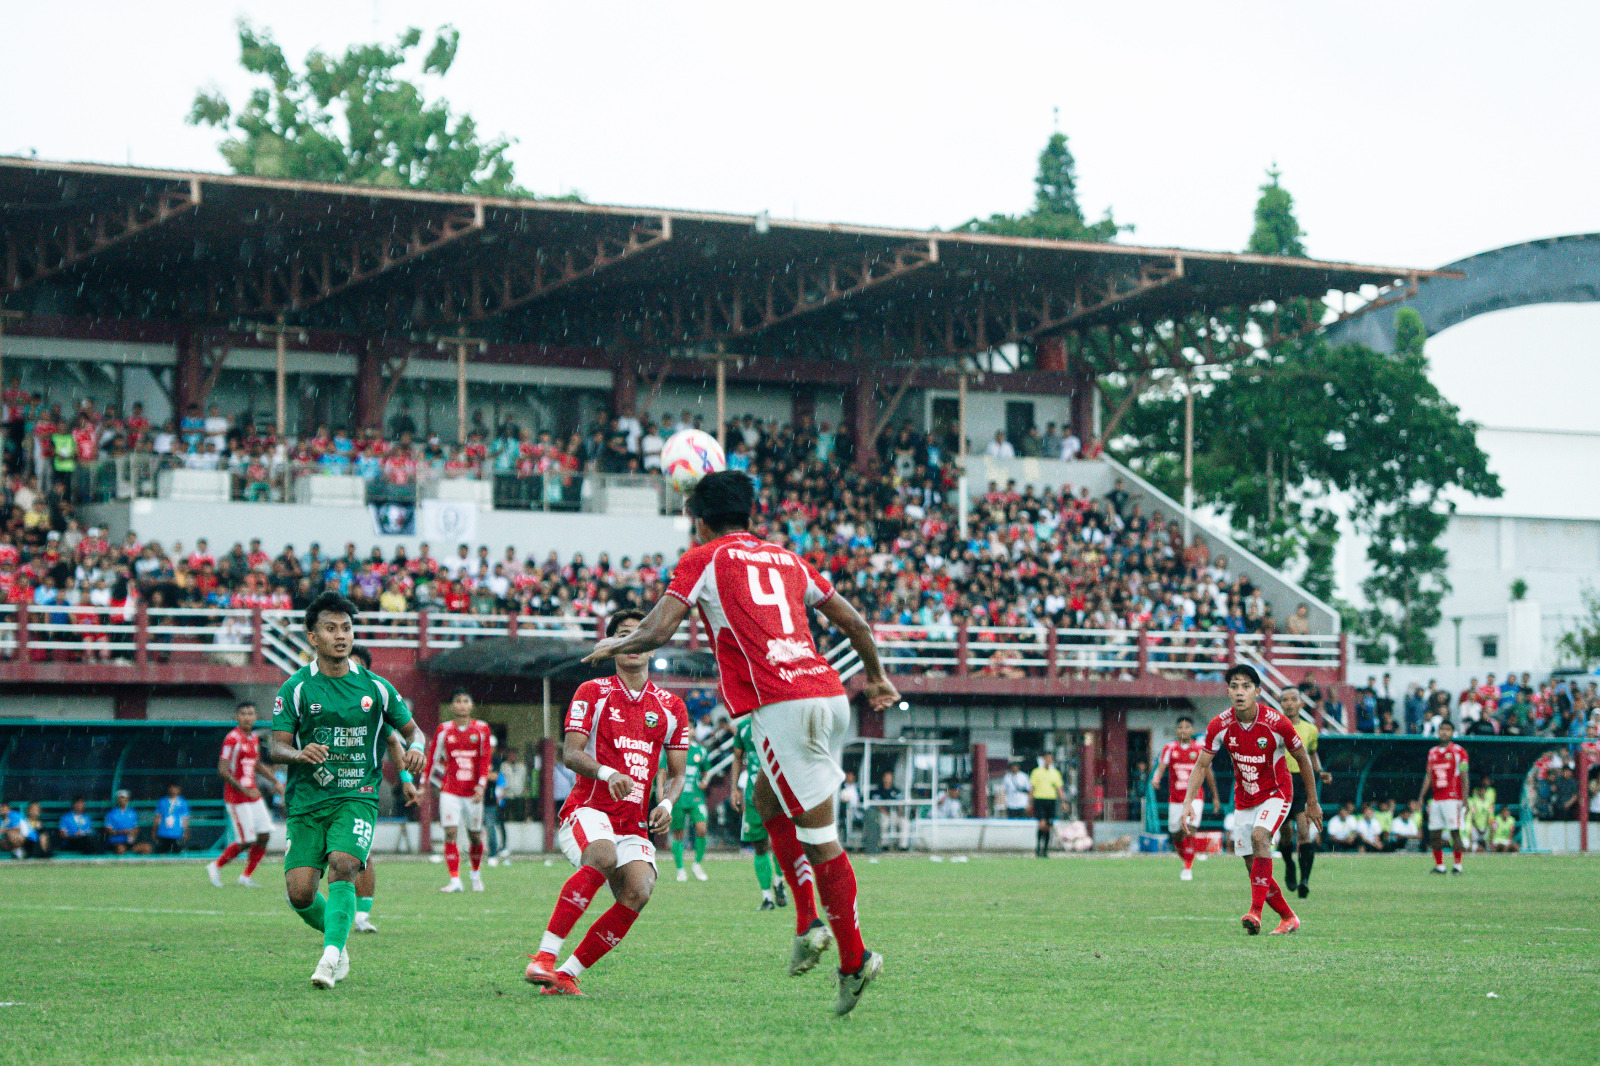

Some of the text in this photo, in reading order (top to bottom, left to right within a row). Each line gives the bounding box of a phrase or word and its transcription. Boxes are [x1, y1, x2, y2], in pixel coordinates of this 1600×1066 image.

[746, 565, 795, 635] 4
[334, 726, 367, 736] PEMKAB
[334, 737, 365, 747] KENDAL
[352, 817, 372, 842] 22
